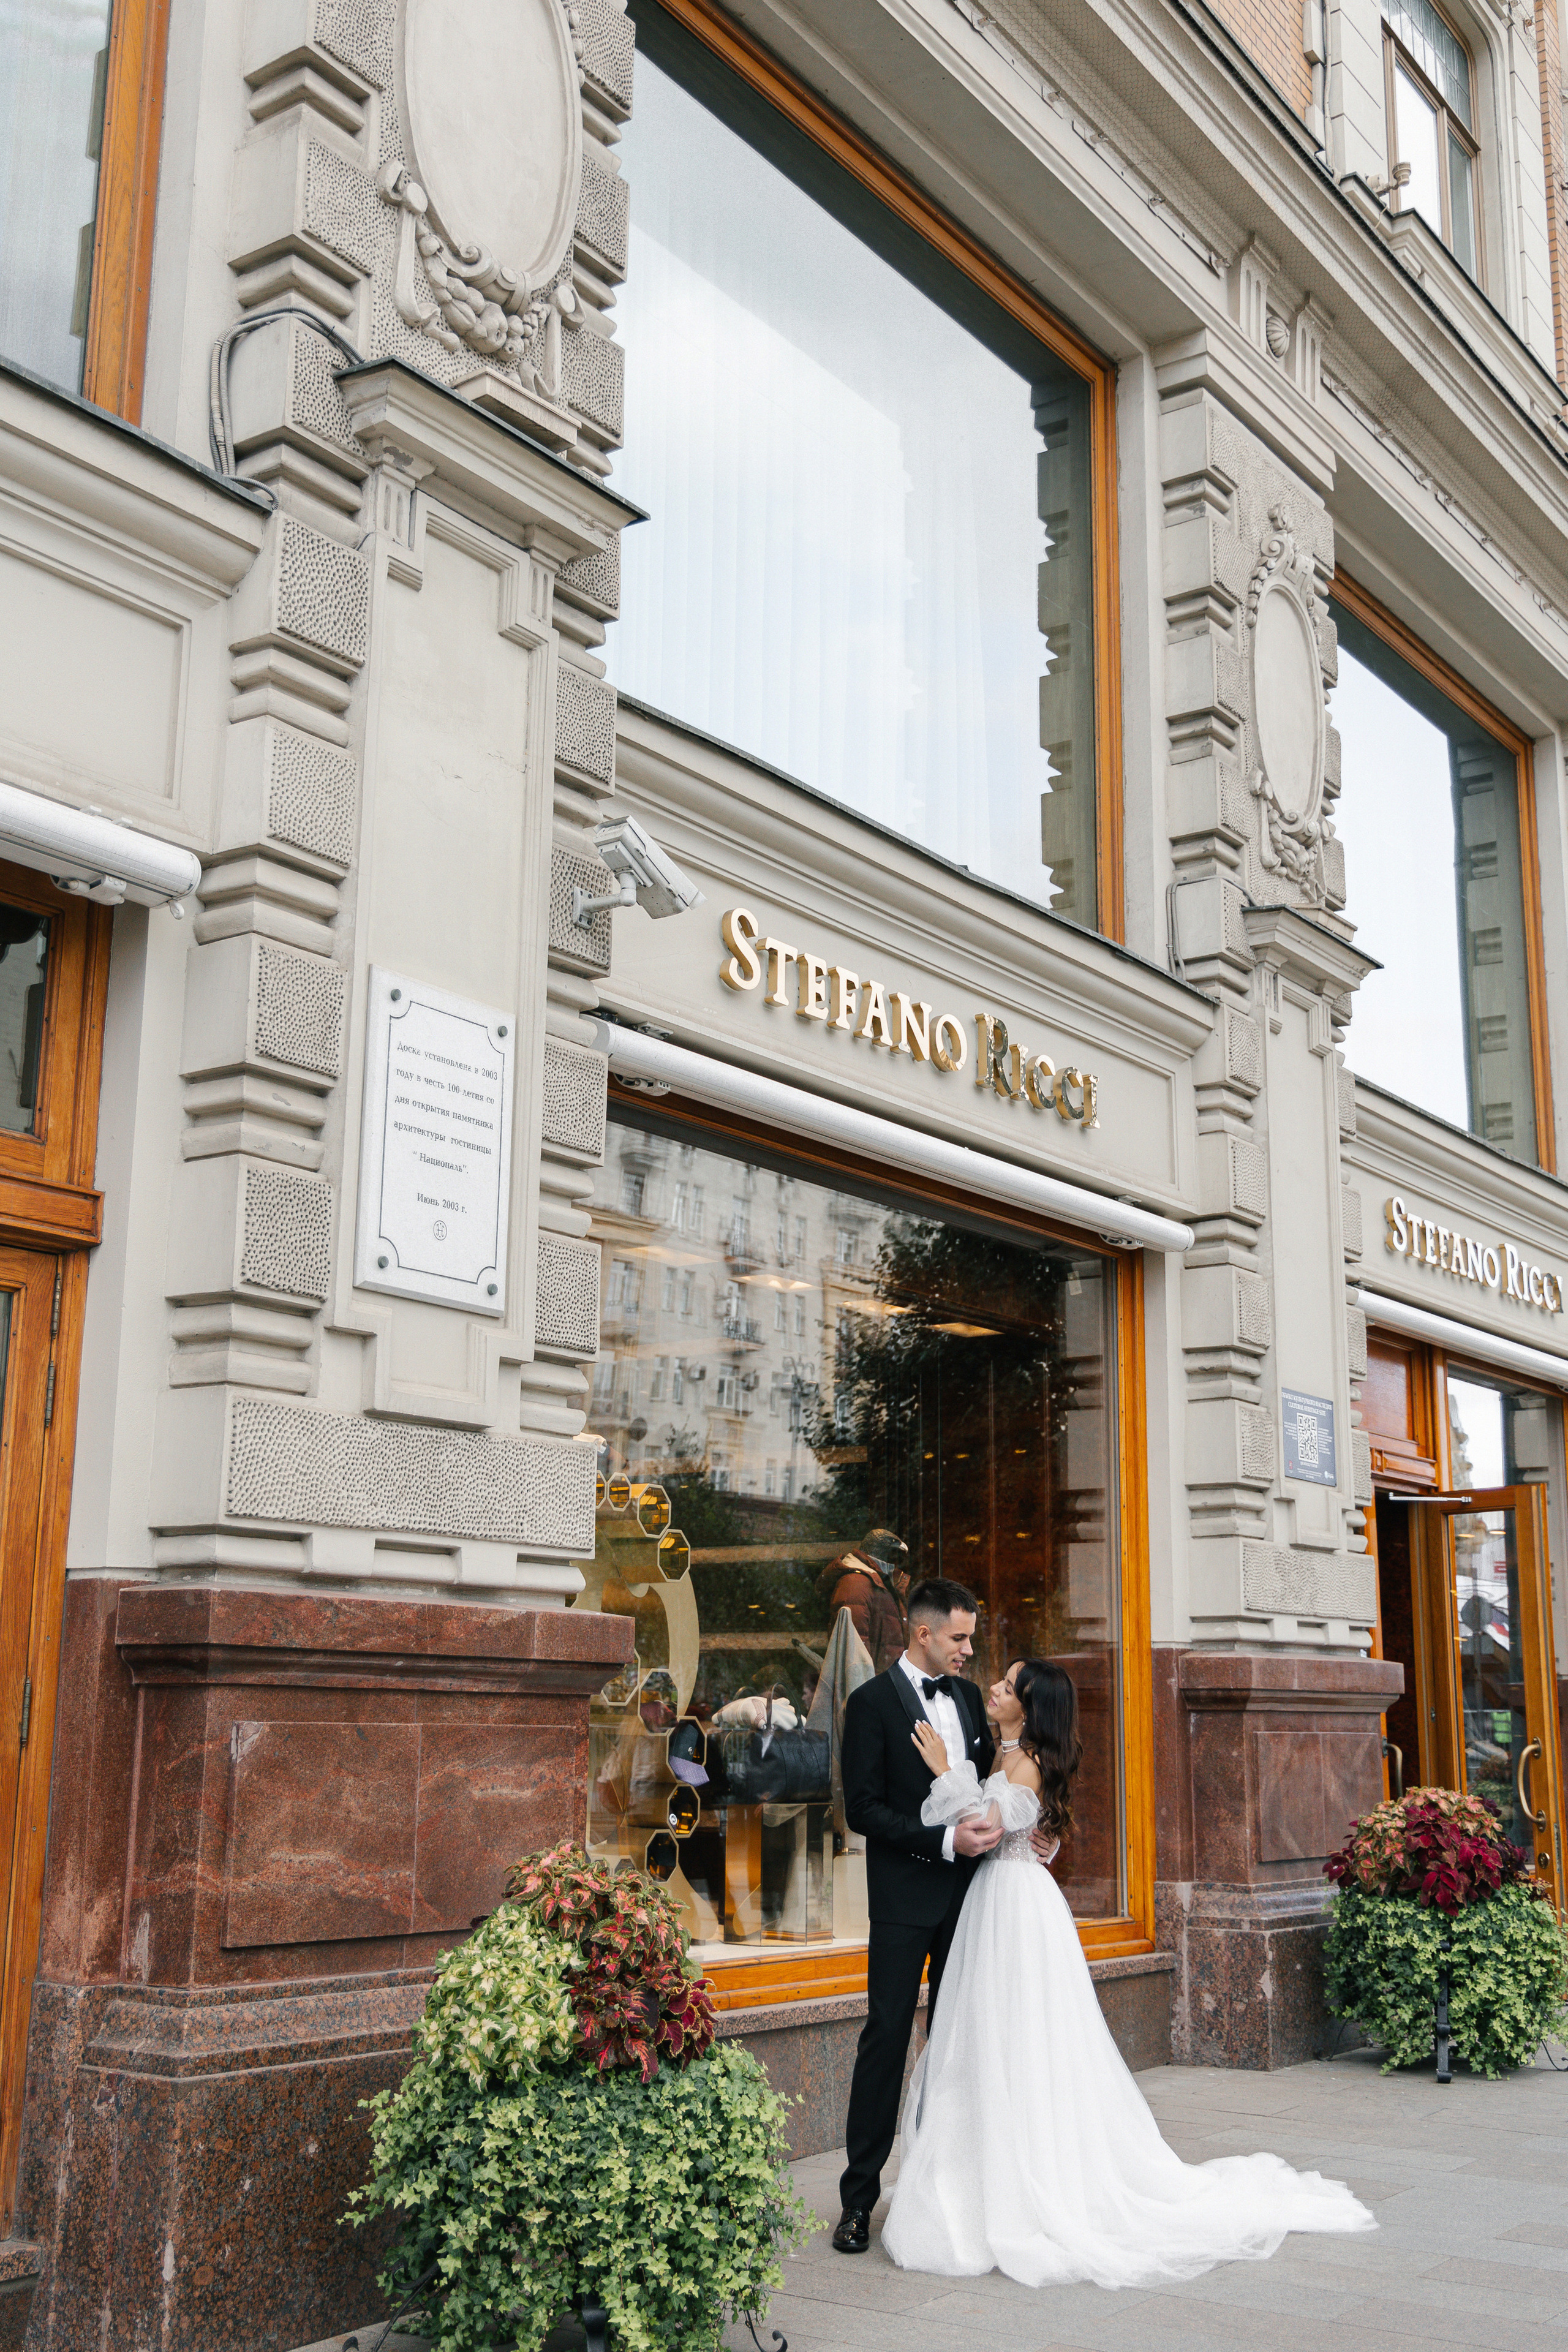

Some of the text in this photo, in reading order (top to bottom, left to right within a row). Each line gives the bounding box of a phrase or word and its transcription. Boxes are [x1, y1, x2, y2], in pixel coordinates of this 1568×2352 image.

[719, 907, 1100, 1129] STEFANO RICCI
[397, 1041, 421, 1056] Доска
[424, 1051, 472, 1072] установлена
[481, 1068, 498, 1080] 2003
[396, 1068, 414, 1081] году
[424, 1077, 445, 1089] честь
[394, 1095, 494, 1130] дня открытия памятника
[394, 1121, 491, 1155] архитектуры гостиницы
[417, 1193, 467, 1214] Июнь 2003 г.
[1385, 1196, 1564, 1313] STEFANO RICCI
